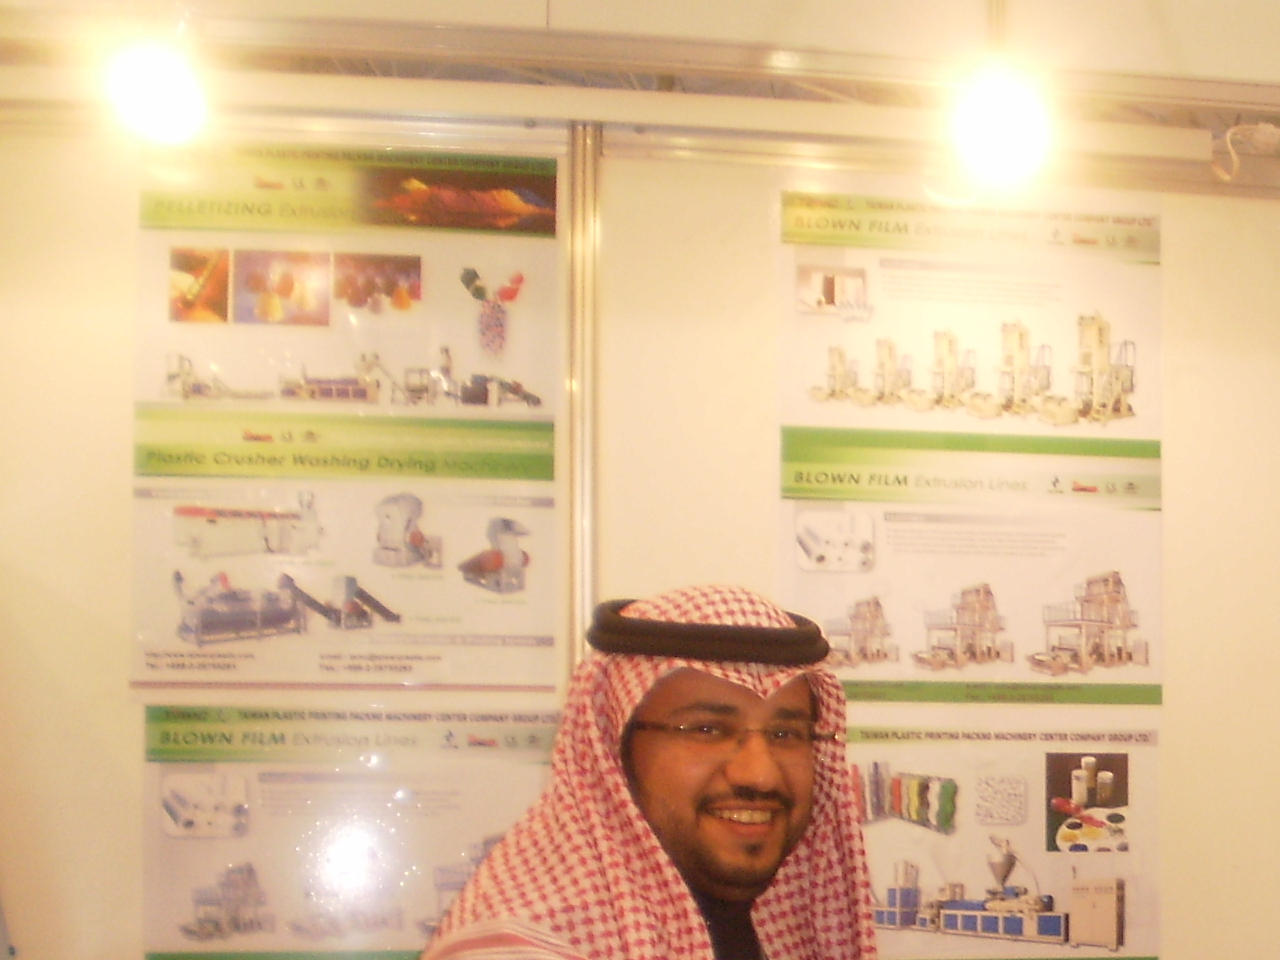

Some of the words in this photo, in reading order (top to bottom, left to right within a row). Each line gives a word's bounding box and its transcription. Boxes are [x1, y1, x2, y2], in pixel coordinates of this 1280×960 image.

[794, 216, 861, 232] BLOWN
[868, 219, 909, 234] FILM
[148, 451, 204, 466] Plastic
[213, 451, 286, 467] Crusher
[292, 453, 370, 472] Washing
[376, 455, 436, 474] Drying
[794, 471, 860, 486] BLOWN
[868, 472, 908, 487] FILM
[914, 474, 984, 490] Extrusion
[988, 476, 1028, 492] Lines
[159, 731, 232, 746] BLOWN
[241, 732, 287, 747] FILM
[293, 732, 370, 748] Extrusion
